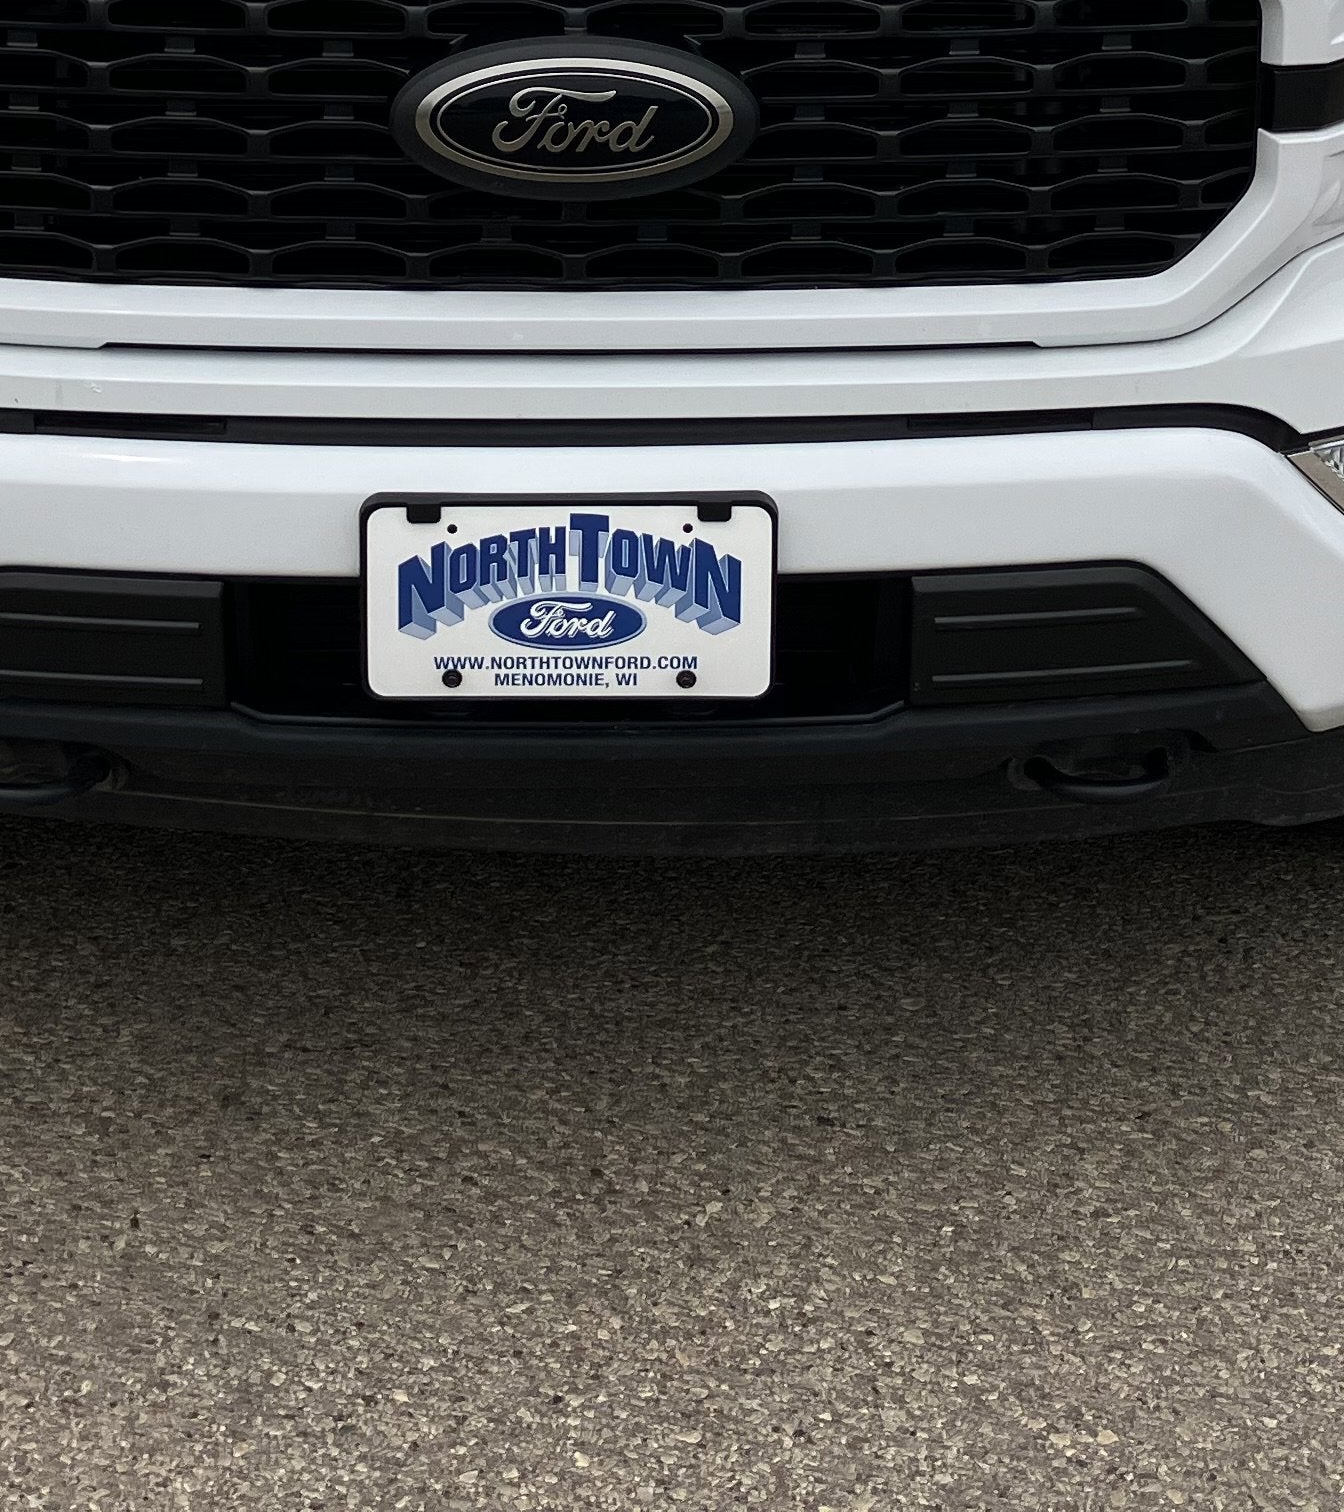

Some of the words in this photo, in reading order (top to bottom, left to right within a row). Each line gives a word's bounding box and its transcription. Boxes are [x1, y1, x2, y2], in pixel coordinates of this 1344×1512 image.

[491, 86, 659, 153] Ford
[520, 600, 616, 639] Ford
[433, 656, 698, 671] WWW.NORTHTOWNFORD.COM
[494, 672, 610, 689] MENOMONIE,
[614, 672, 638, 687] WI
